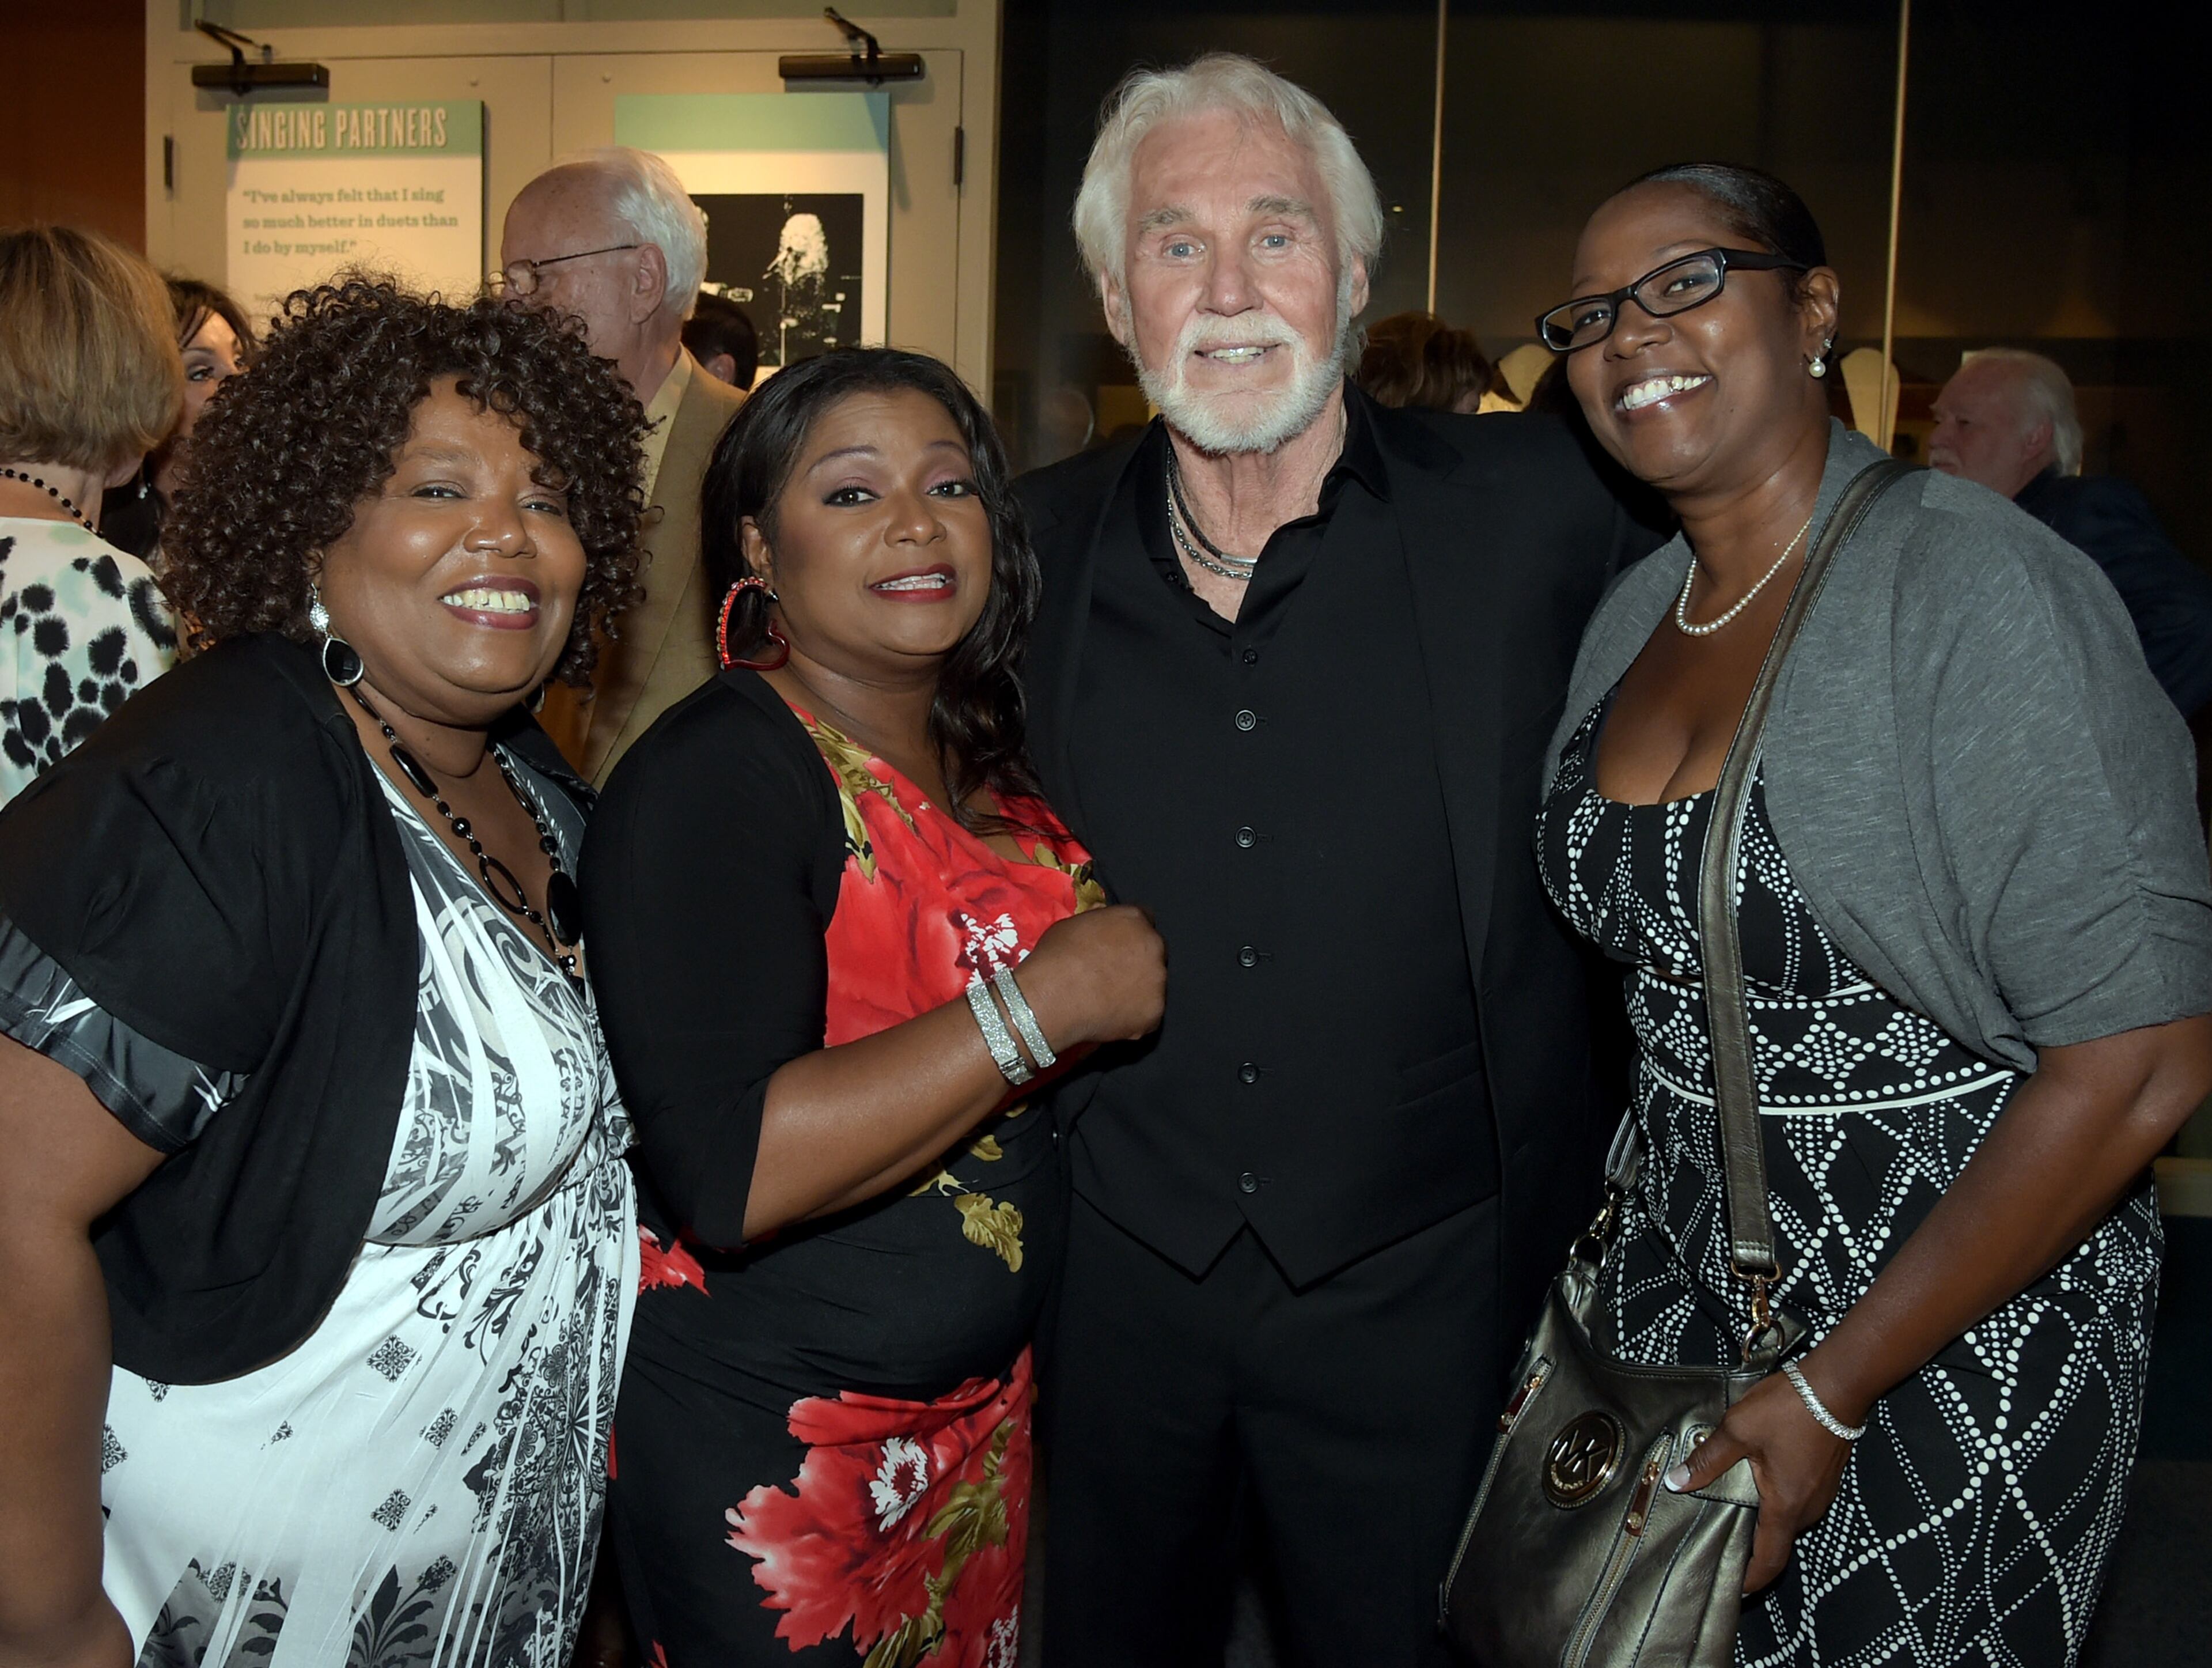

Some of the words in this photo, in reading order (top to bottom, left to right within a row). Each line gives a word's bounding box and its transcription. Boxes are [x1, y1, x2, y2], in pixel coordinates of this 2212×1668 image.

[237, 109, 326, 150] SINGING
[335, 107, 447, 149] PARTNERS
[281, 188, 334, 205] always
[337, 188, 363, 202] felt
[366, 188, 398, 202] that
[402, 188, 408, 202] I
[411, 187, 445, 204] sing
[243, 218, 259, 229] so
[262, 214, 305, 228] much
[308, 214, 355, 228] better
[358, 214, 373, 228] in
[377, 213, 419, 228] duets
[422, 213, 458, 227] than
[244, 240, 250, 255] I
[252, 239, 271, 254] do
[274, 239, 291, 257] by
